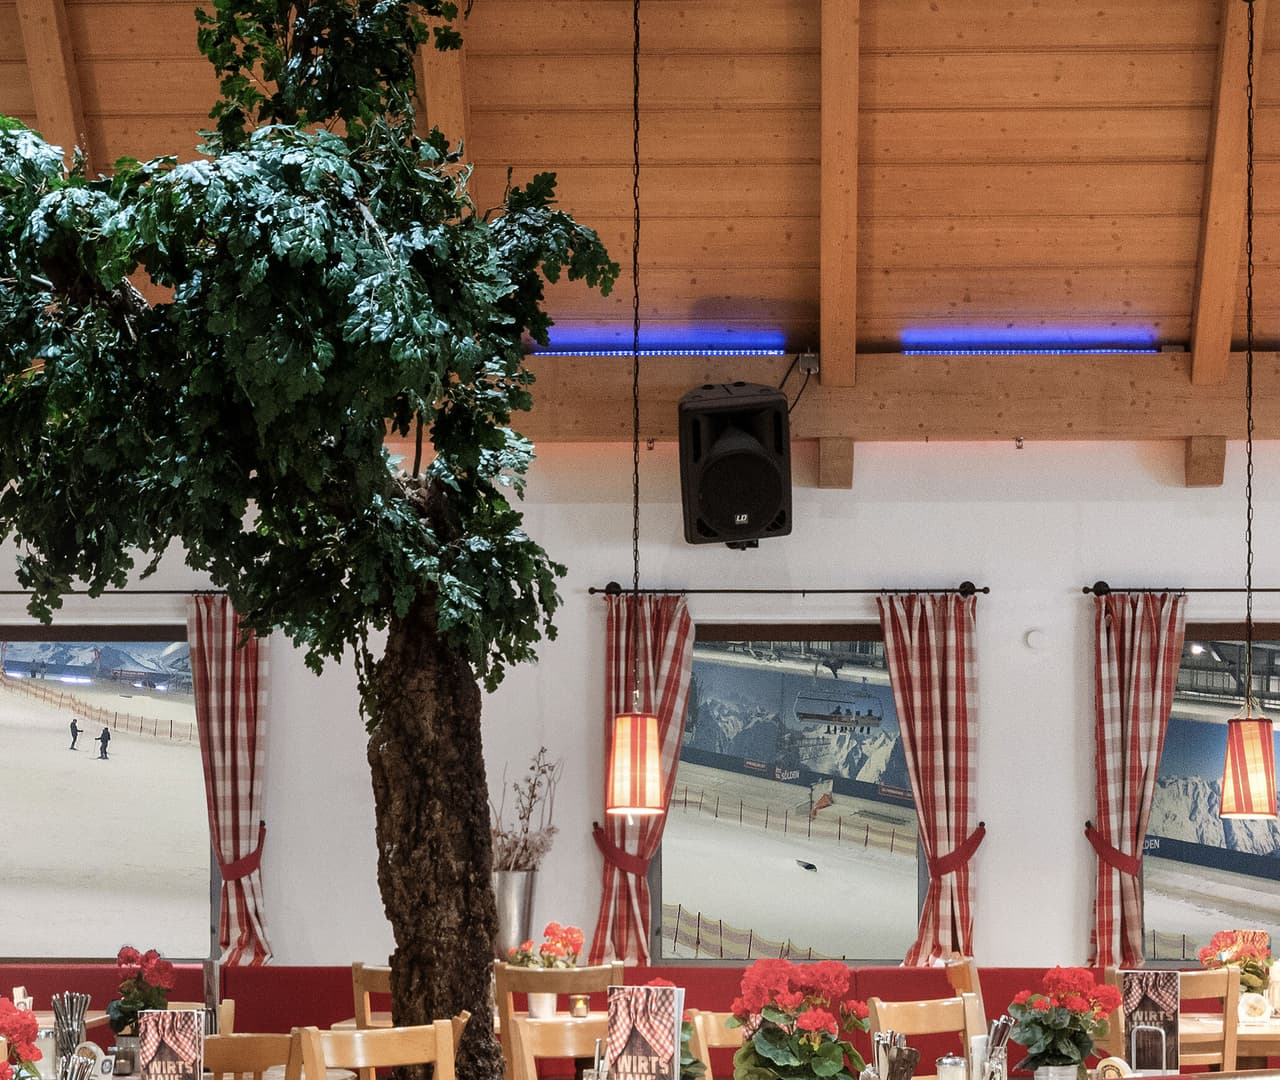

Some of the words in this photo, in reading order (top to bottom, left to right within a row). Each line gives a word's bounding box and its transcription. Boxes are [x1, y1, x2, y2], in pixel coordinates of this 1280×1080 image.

[1144, 839, 1160, 850] DEN
[1132, 1010, 1174, 1021] WIRTS
[149, 1060, 193, 1074] WIRTS
[618, 1056, 669, 1074] WIRTS
